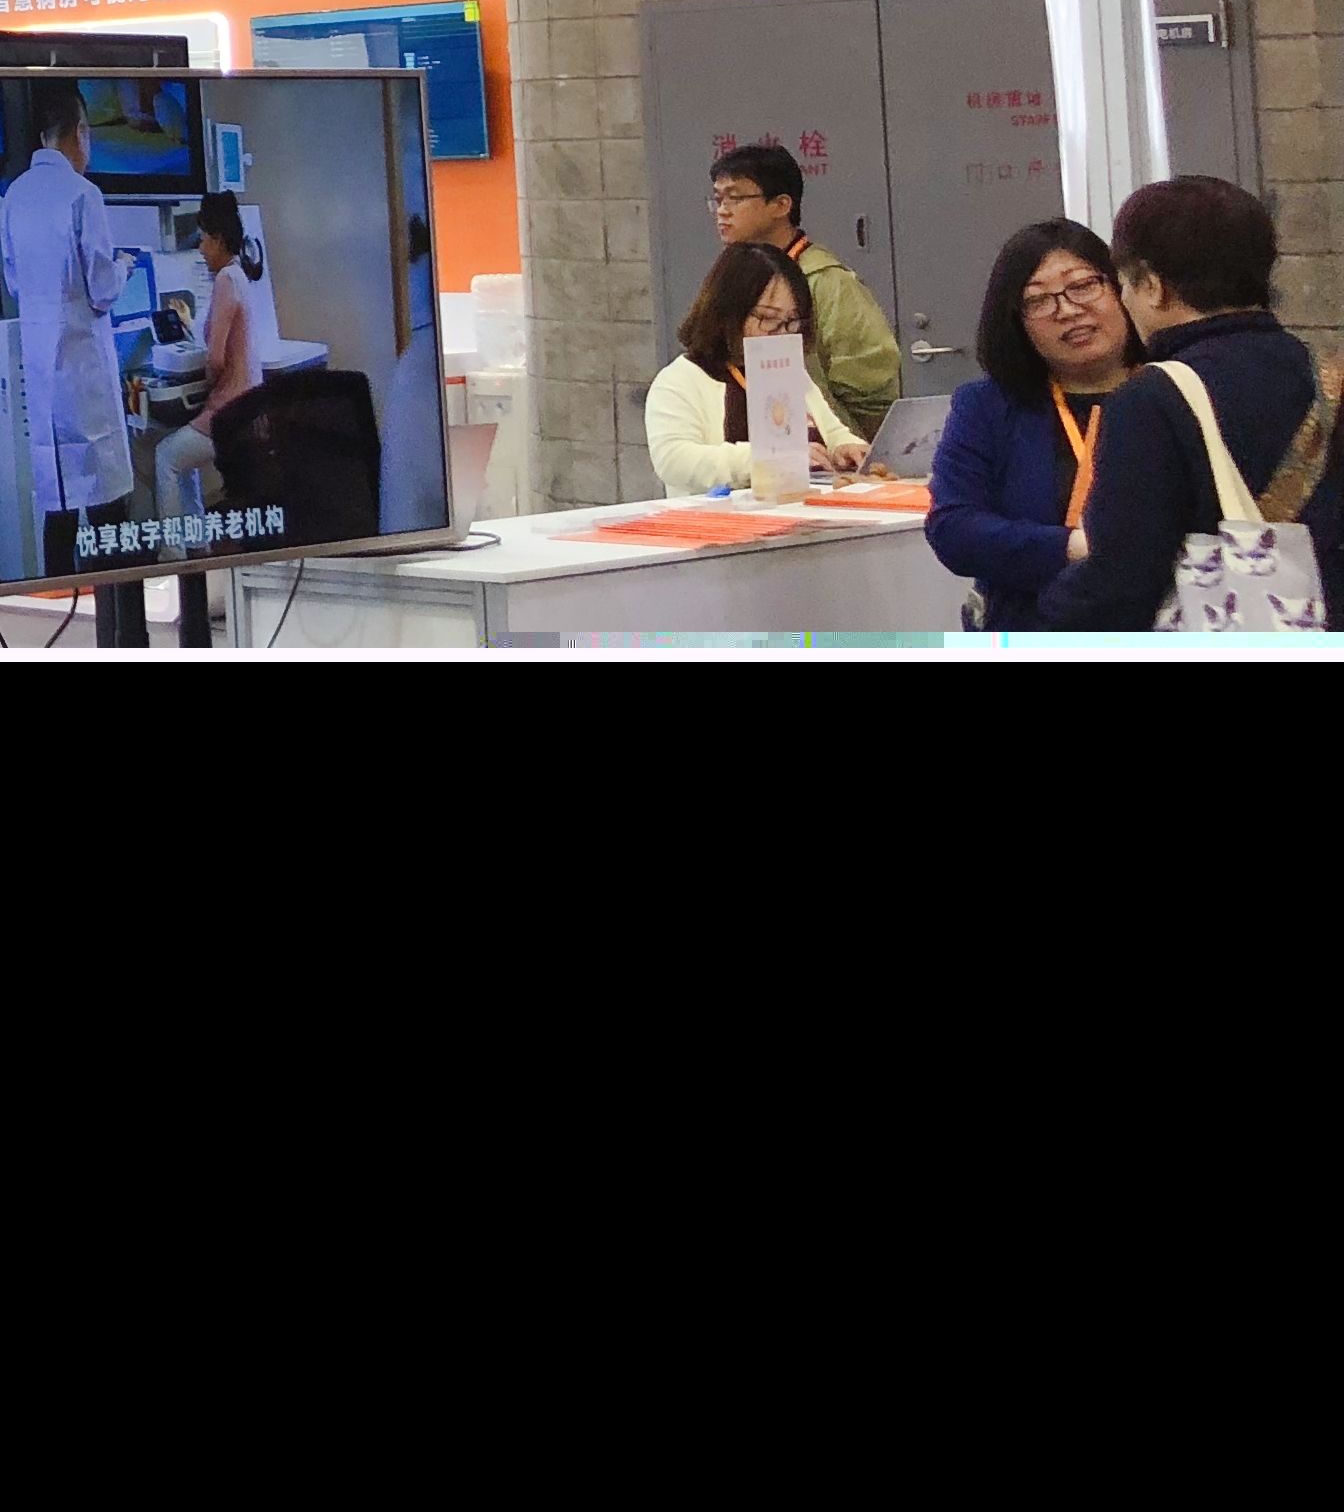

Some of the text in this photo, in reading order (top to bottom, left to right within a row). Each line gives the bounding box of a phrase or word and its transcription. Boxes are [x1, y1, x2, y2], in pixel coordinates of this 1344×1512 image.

[75, 505, 285, 557] 悦享数字帮助养老机构
